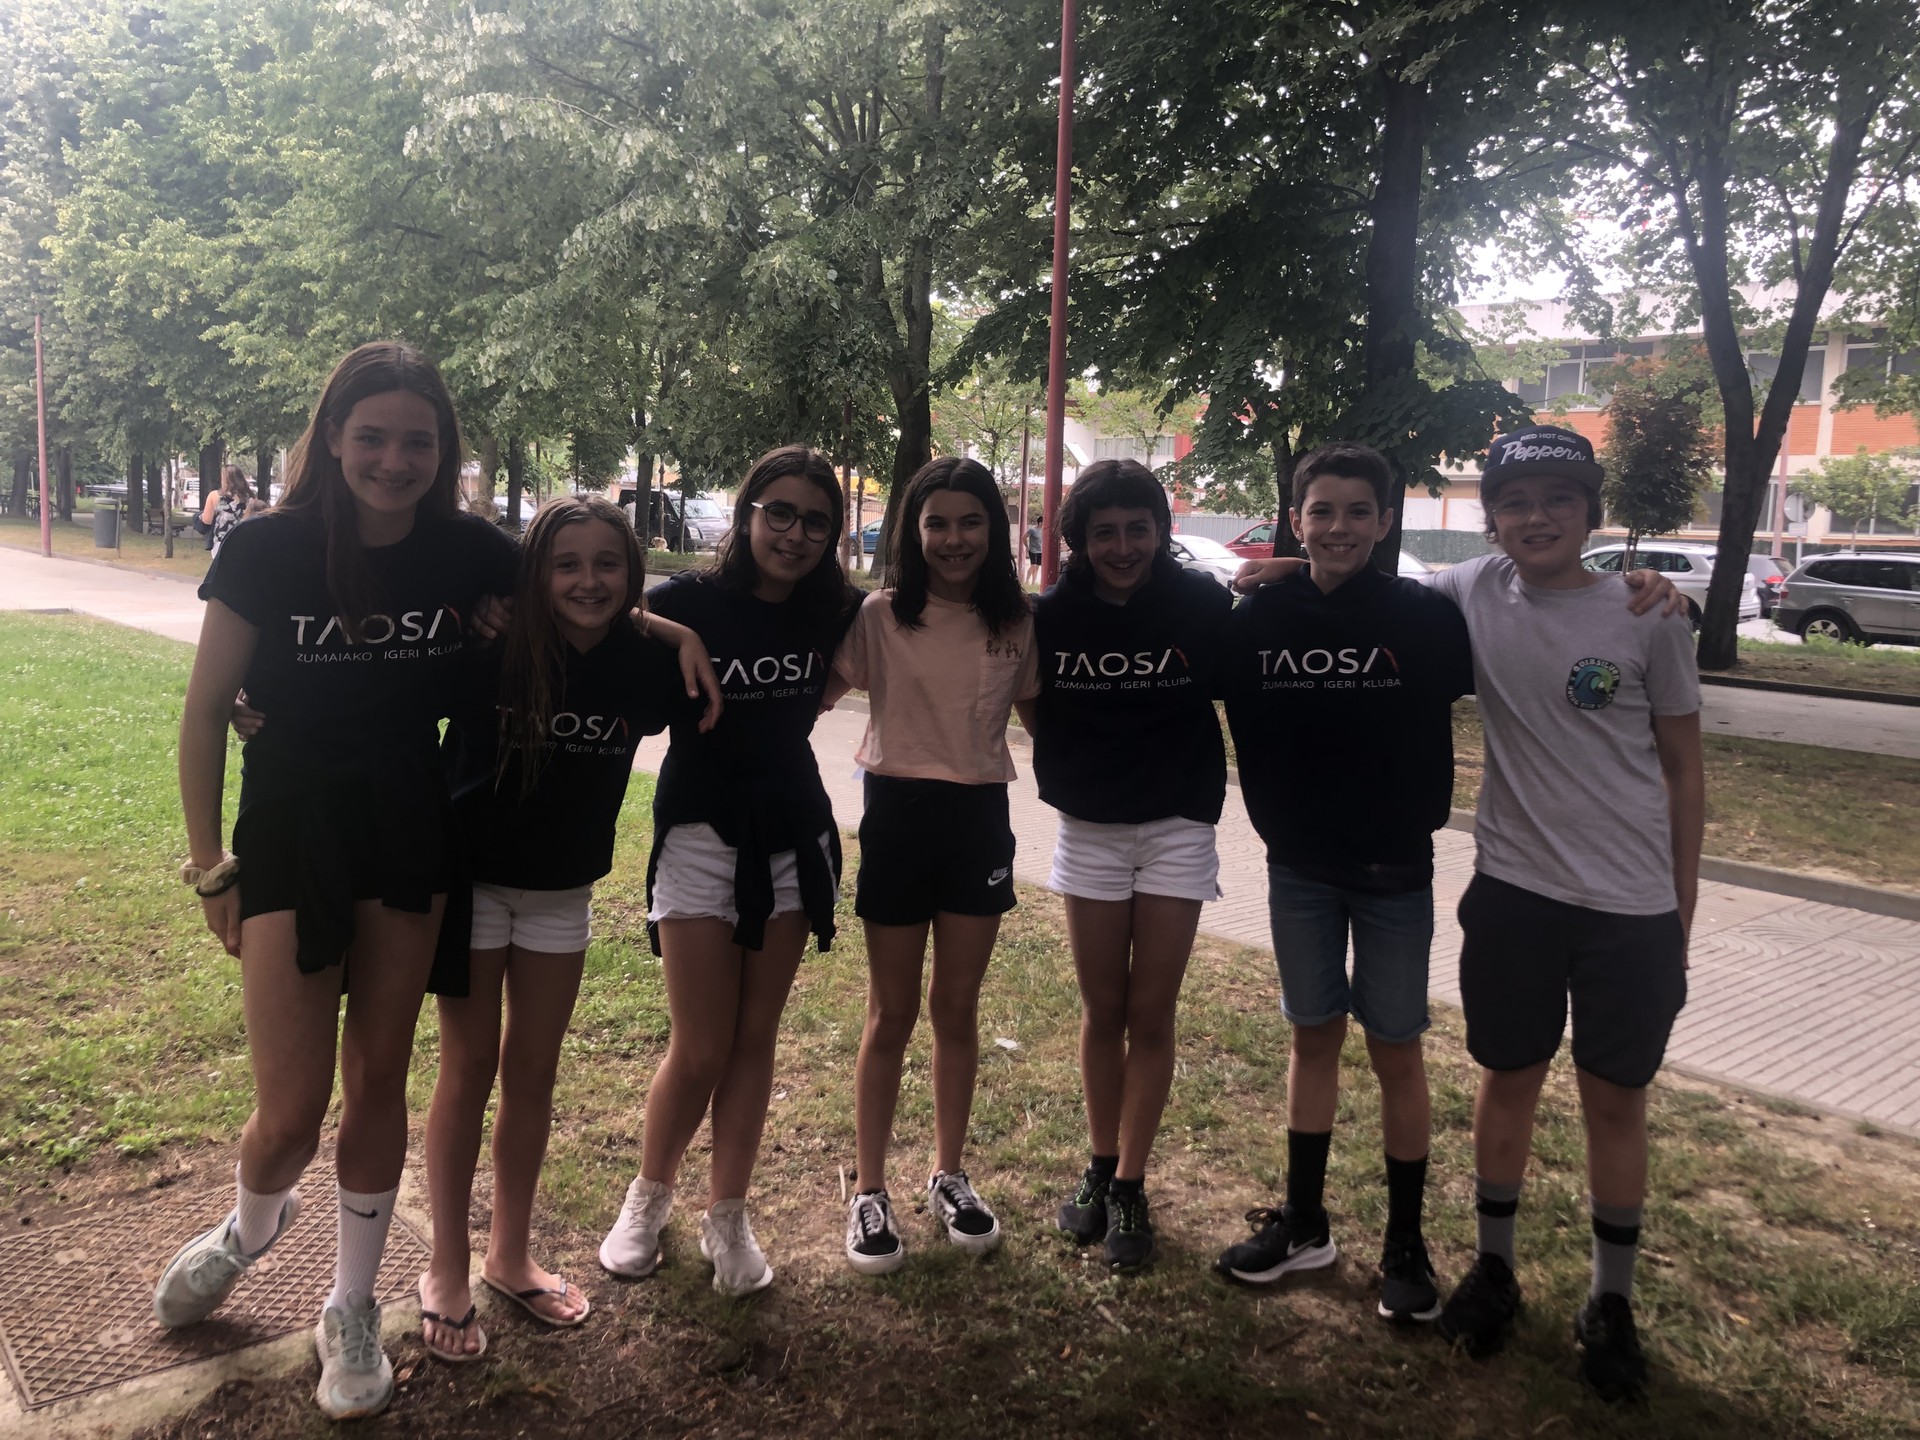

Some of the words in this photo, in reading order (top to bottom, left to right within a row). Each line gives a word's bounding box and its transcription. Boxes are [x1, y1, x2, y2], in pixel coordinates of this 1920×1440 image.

[1520, 433, 1538, 442] RED
[1539, 432, 1557, 440] HOT
[297, 651, 373, 662] ZUMAIAKO
[384, 649, 419, 660] IGERI
[1055, 643, 1189, 677] TAOSA
[1257, 643, 1400, 676] TAOSA
[1054, 679, 1112, 690] ZUMAIAKO
[1120, 680, 1151, 690] IGERI
[1157, 675, 1193, 688] KLUBA
[1262, 680, 1315, 690] ZUMAIAKO
[1323, 680, 1356, 689] IGERI
[1362, 678, 1402, 688] KLUBA
[772, 687, 799, 698] IGERI
[565, 742, 594, 753] IGERI
